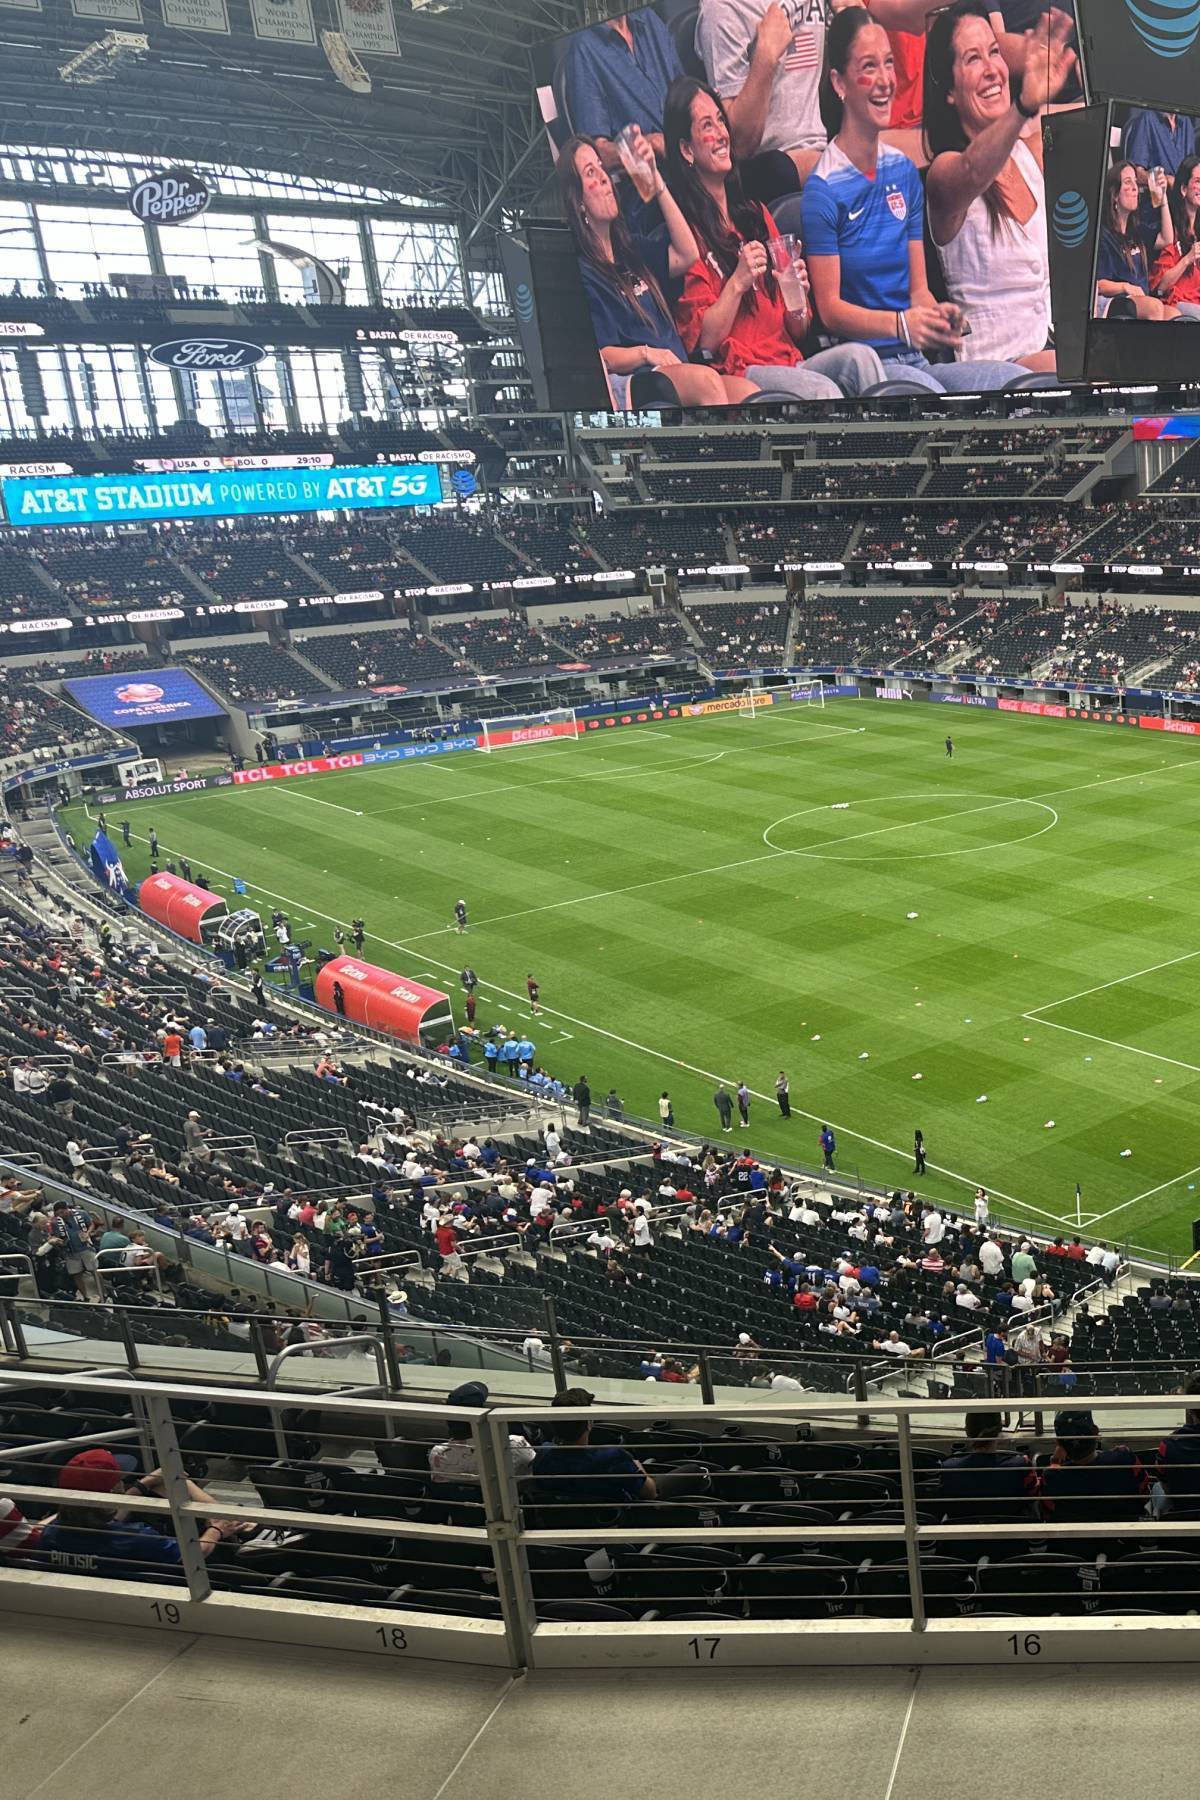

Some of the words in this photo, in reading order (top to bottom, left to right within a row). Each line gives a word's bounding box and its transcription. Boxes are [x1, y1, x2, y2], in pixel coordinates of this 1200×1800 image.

[266, 8, 298, 18] WORLD
[258, 17, 310, 30] CHAMPIONS
[353, 22, 383, 31] WORLD
[163, 179, 189, 197] Dr
[132, 181, 206, 219] Pepper
[369, 331, 397, 340] BASTA
[172, 343, 246, 366] Ford
[177, 460, 197, 468] USA
[237, 458, 256, 466] BOL
[297, 456, 321, 464] 29:10
[389, 453, 416, 462] BASTA
[423, 453, 433, 461] DE
[435, 452, 471, 461] RACISMO
[9, 465, 56, 475] RACISM
[21, 486, 89, 514] AT&T
[94, 483, 215, 511] STADIUM
[220, 482, 297, 501] POWERED
[304, 482, 321, 498] BY
[327, 477, 385, 499] AT&T
[390, 474, 427, 497] 5G
[492, 581, 511, 589] BASTA
[405, 588, 425, 596] STOP
[310, 596, 333, 605] BASTA
[209, 605, 232, 614] STOP
[98, 614, 125, 623] BASTA
[22, 621, 59, 630] RACISM
[876, 688, 902, 699] PUMA
[707, 701, 745, 712] mercado
[966, 697, 986, 706] ULTRA
[1164, 721, 1195, 734] Betano
[512, 728, 553, 740] Betano
[443, 738, 476, 750] BYD
[404, 745, 438, 755] BYD
[365, 751, 399, 762] BYD
[326, 757, 363, 769] TCL
[281, 764, 318, 775] TCL
[236, 771, 273, 782] TCL
[125, 785, 172, 800] ABSOLUT
[174, 779, 207, 792] SPORT
[51, 1551, 98, 1569] PULISIC
[150, 1602, 181, 1625] 19
[375, 1626, 408, 1650] 18
[688, 1637, 721, 1660] 17
[1007, 1633, 1042, 1657] 16
